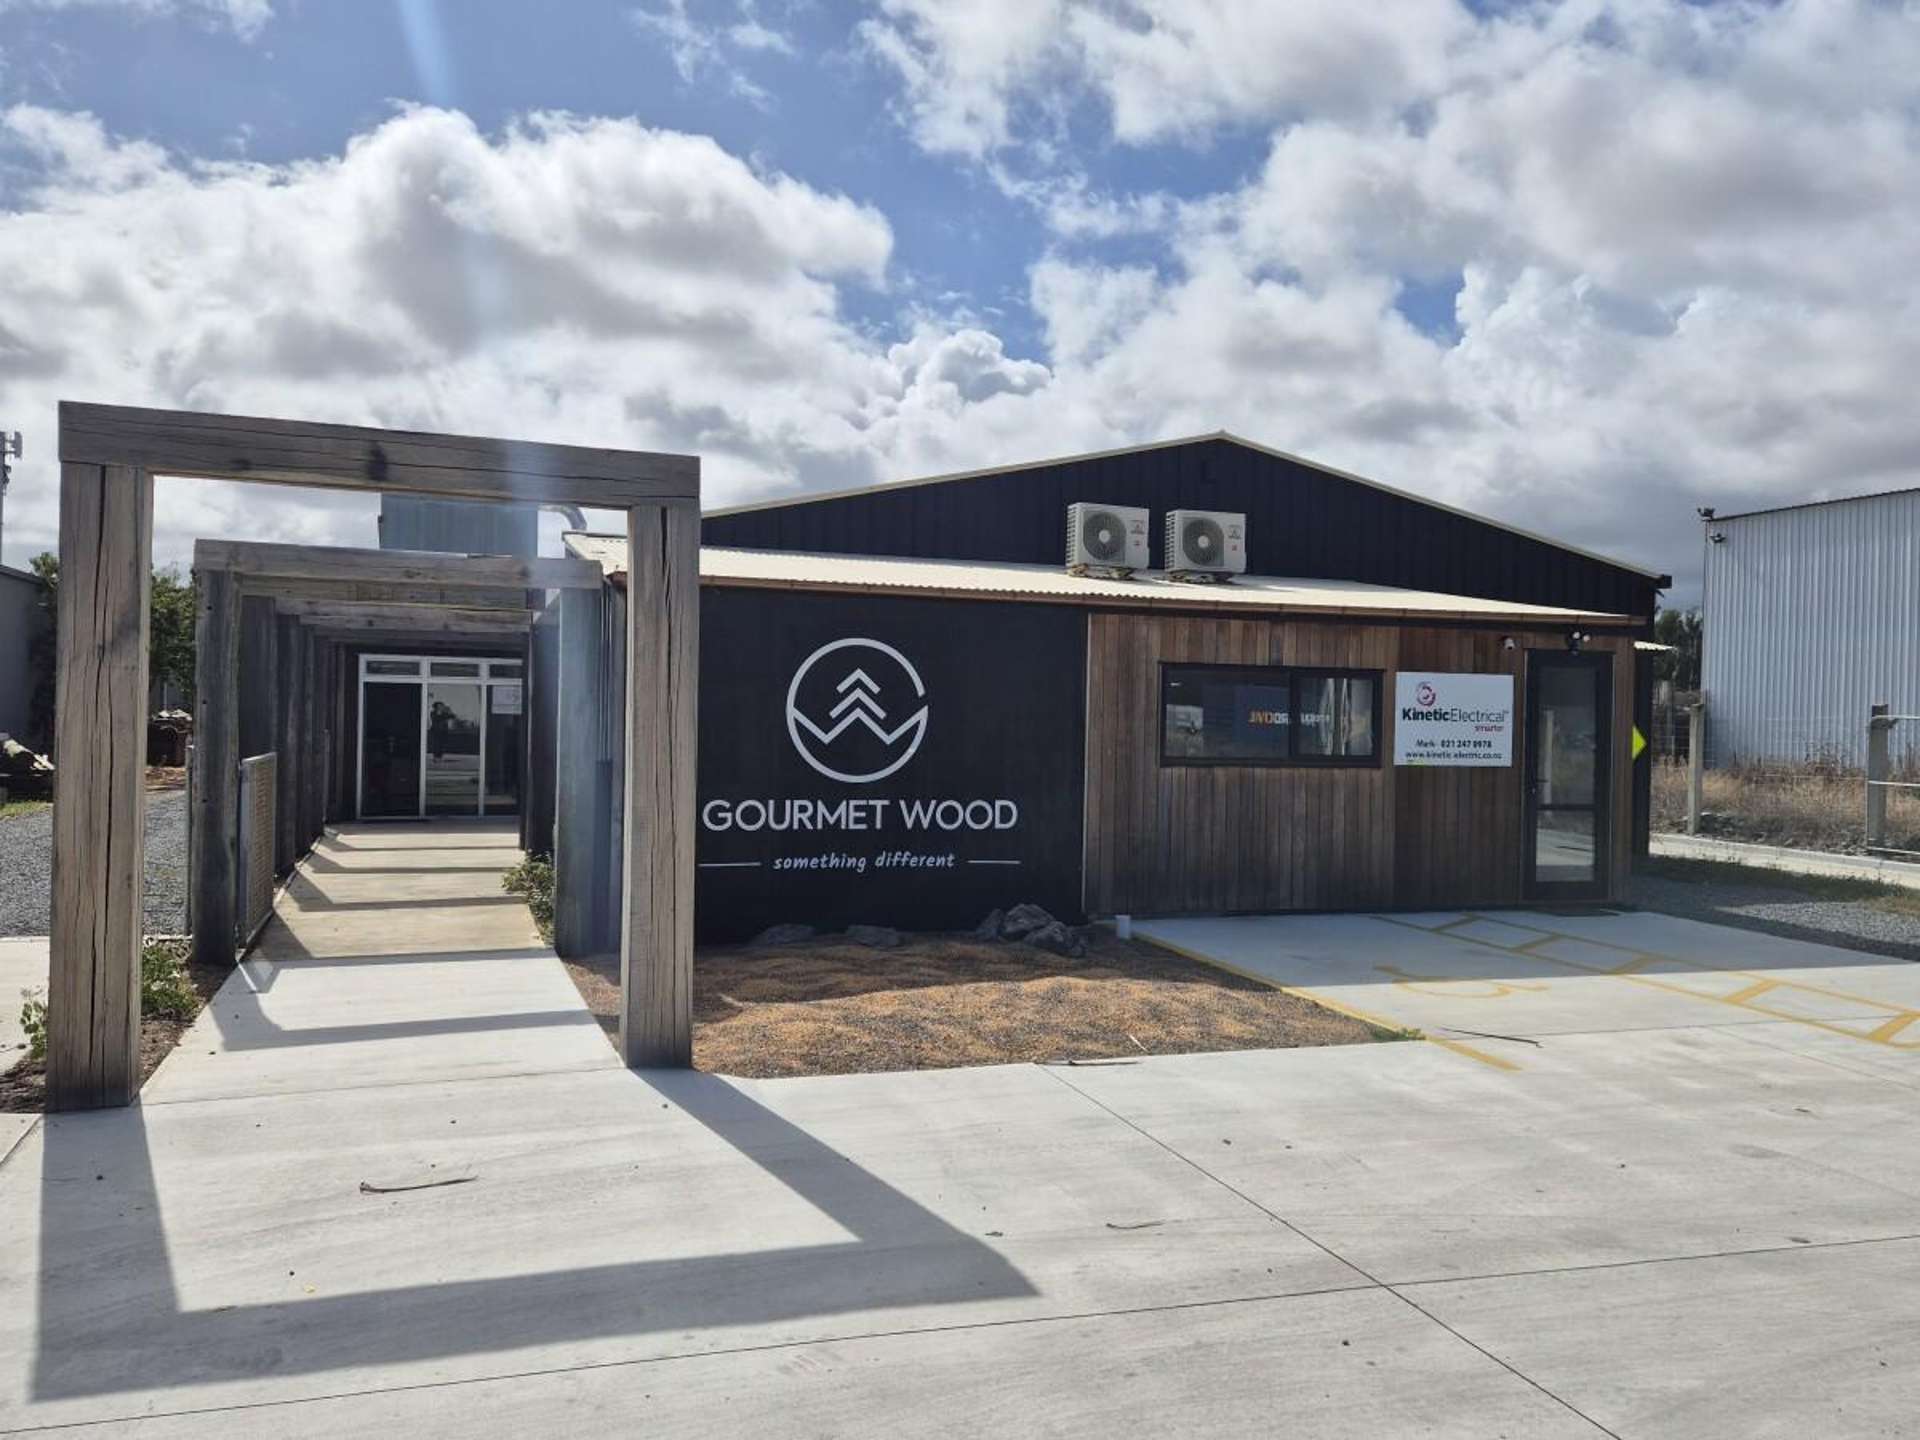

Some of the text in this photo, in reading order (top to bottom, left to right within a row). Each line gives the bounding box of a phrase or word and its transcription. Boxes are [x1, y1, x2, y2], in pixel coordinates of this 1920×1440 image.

[702, 799, 1018, 831] GOURMET WOOD
[773, 850, 955, 873] something different
